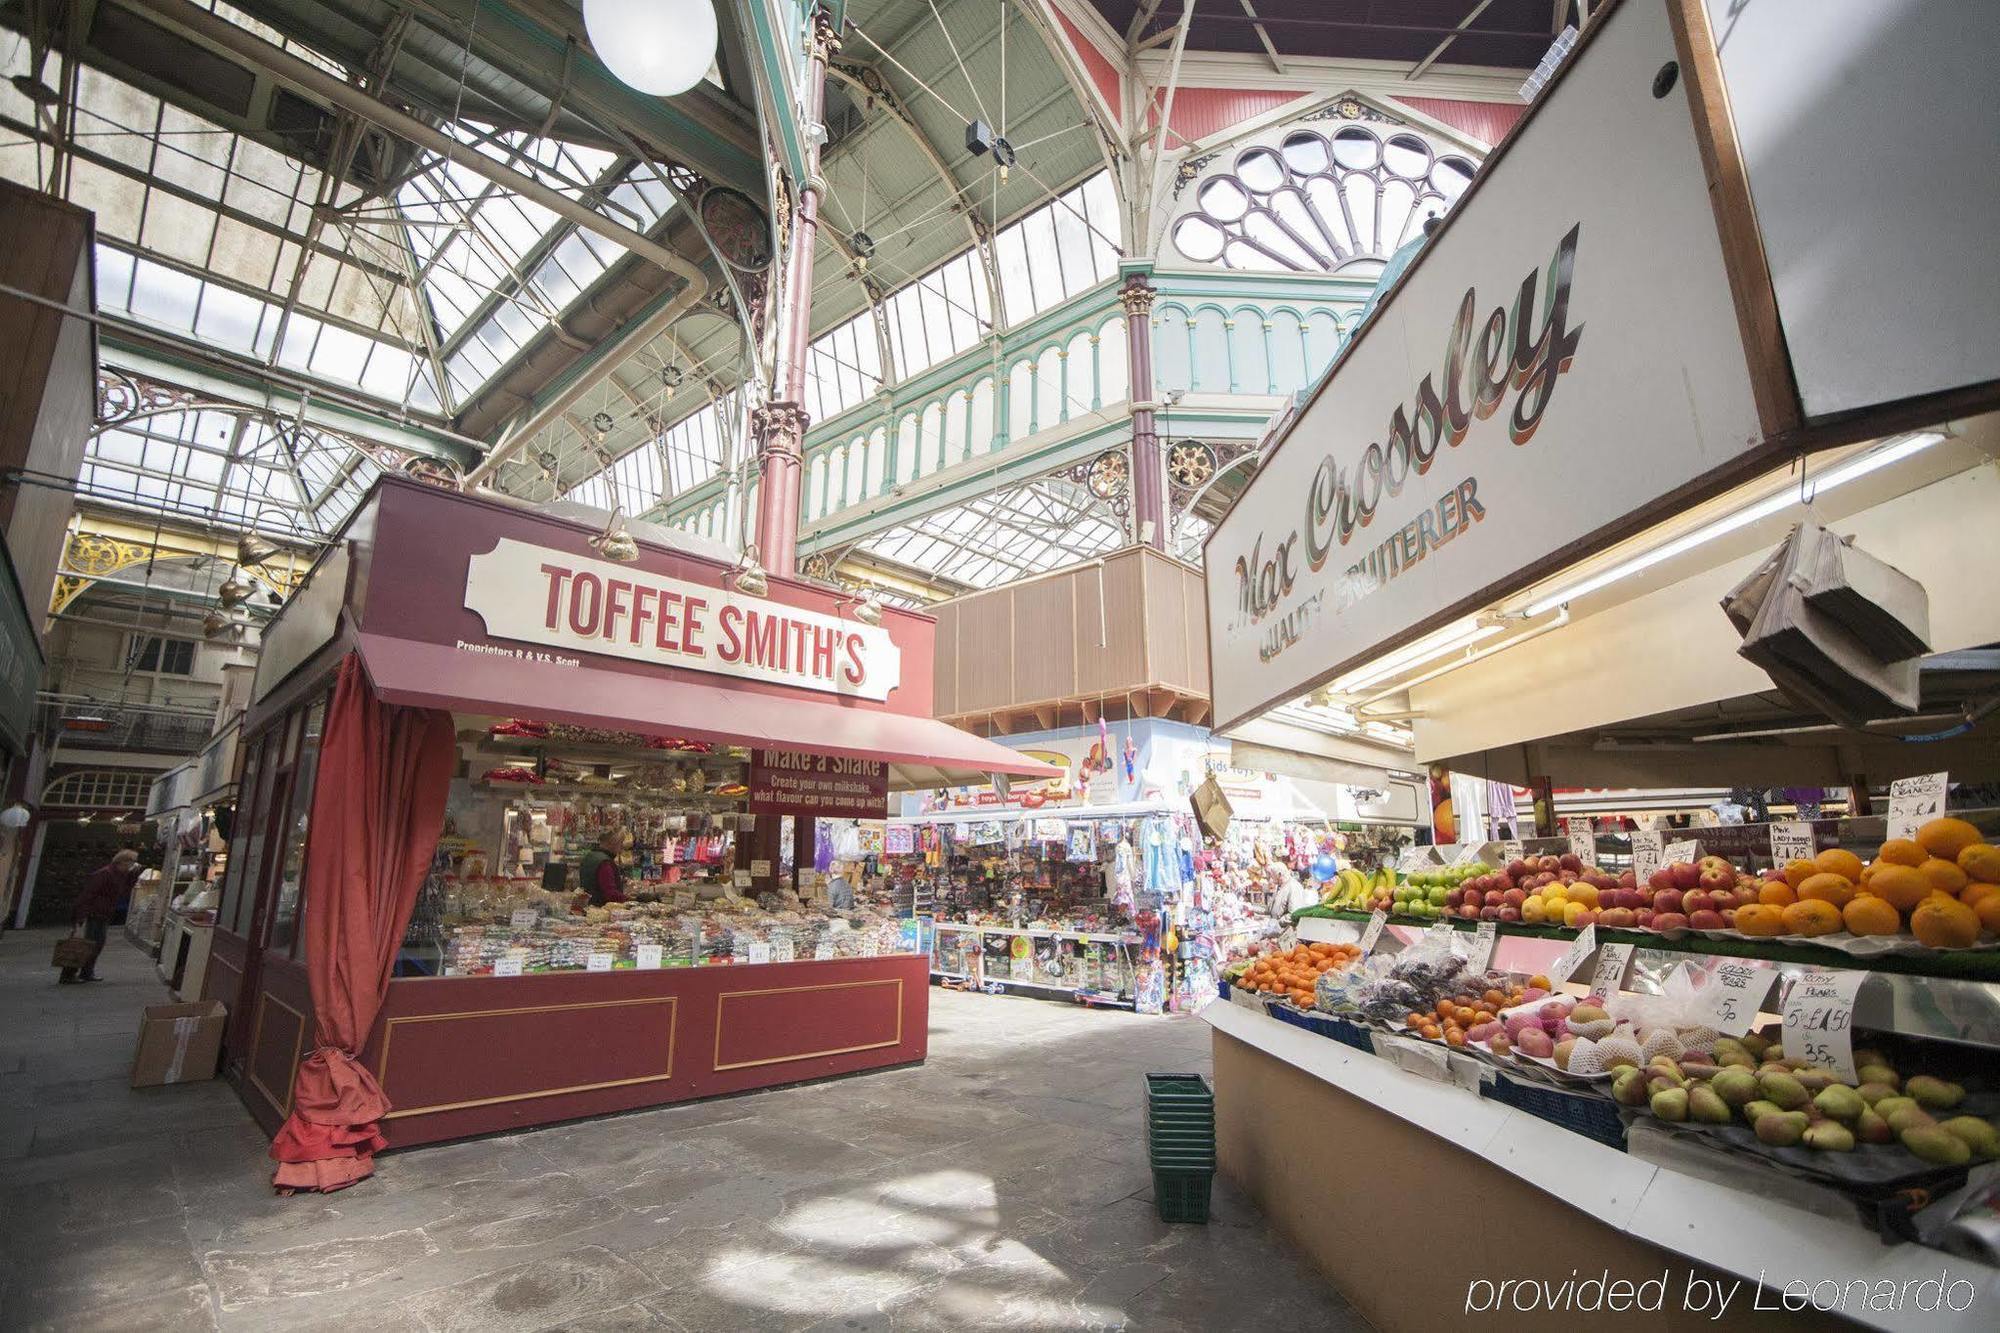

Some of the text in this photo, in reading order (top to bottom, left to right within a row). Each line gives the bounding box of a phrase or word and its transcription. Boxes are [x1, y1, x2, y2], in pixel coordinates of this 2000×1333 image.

[1304, 220, 1586, 573] Crossley
[541, 562, 867, 686] TOFFEE SMITH'S
[456, 639, 514, 657] Proprietors
[525, 651, 533, 661] &
[555, 656, 581, 667] Scott
[763, 750, 811, 771] Make
[816, 755, 826, 772] a
[1204, 757, 1228, 773] Kids
[770, 774, 797, 788] Create
[799, 778, 816, 791] your
[818, 780, 833, 790] own
[754, 790, 775, 802] what
[775, 790, 802, 803] flavour
[804, 795, 819, 804] can
[820, 796, 834, 807] you
